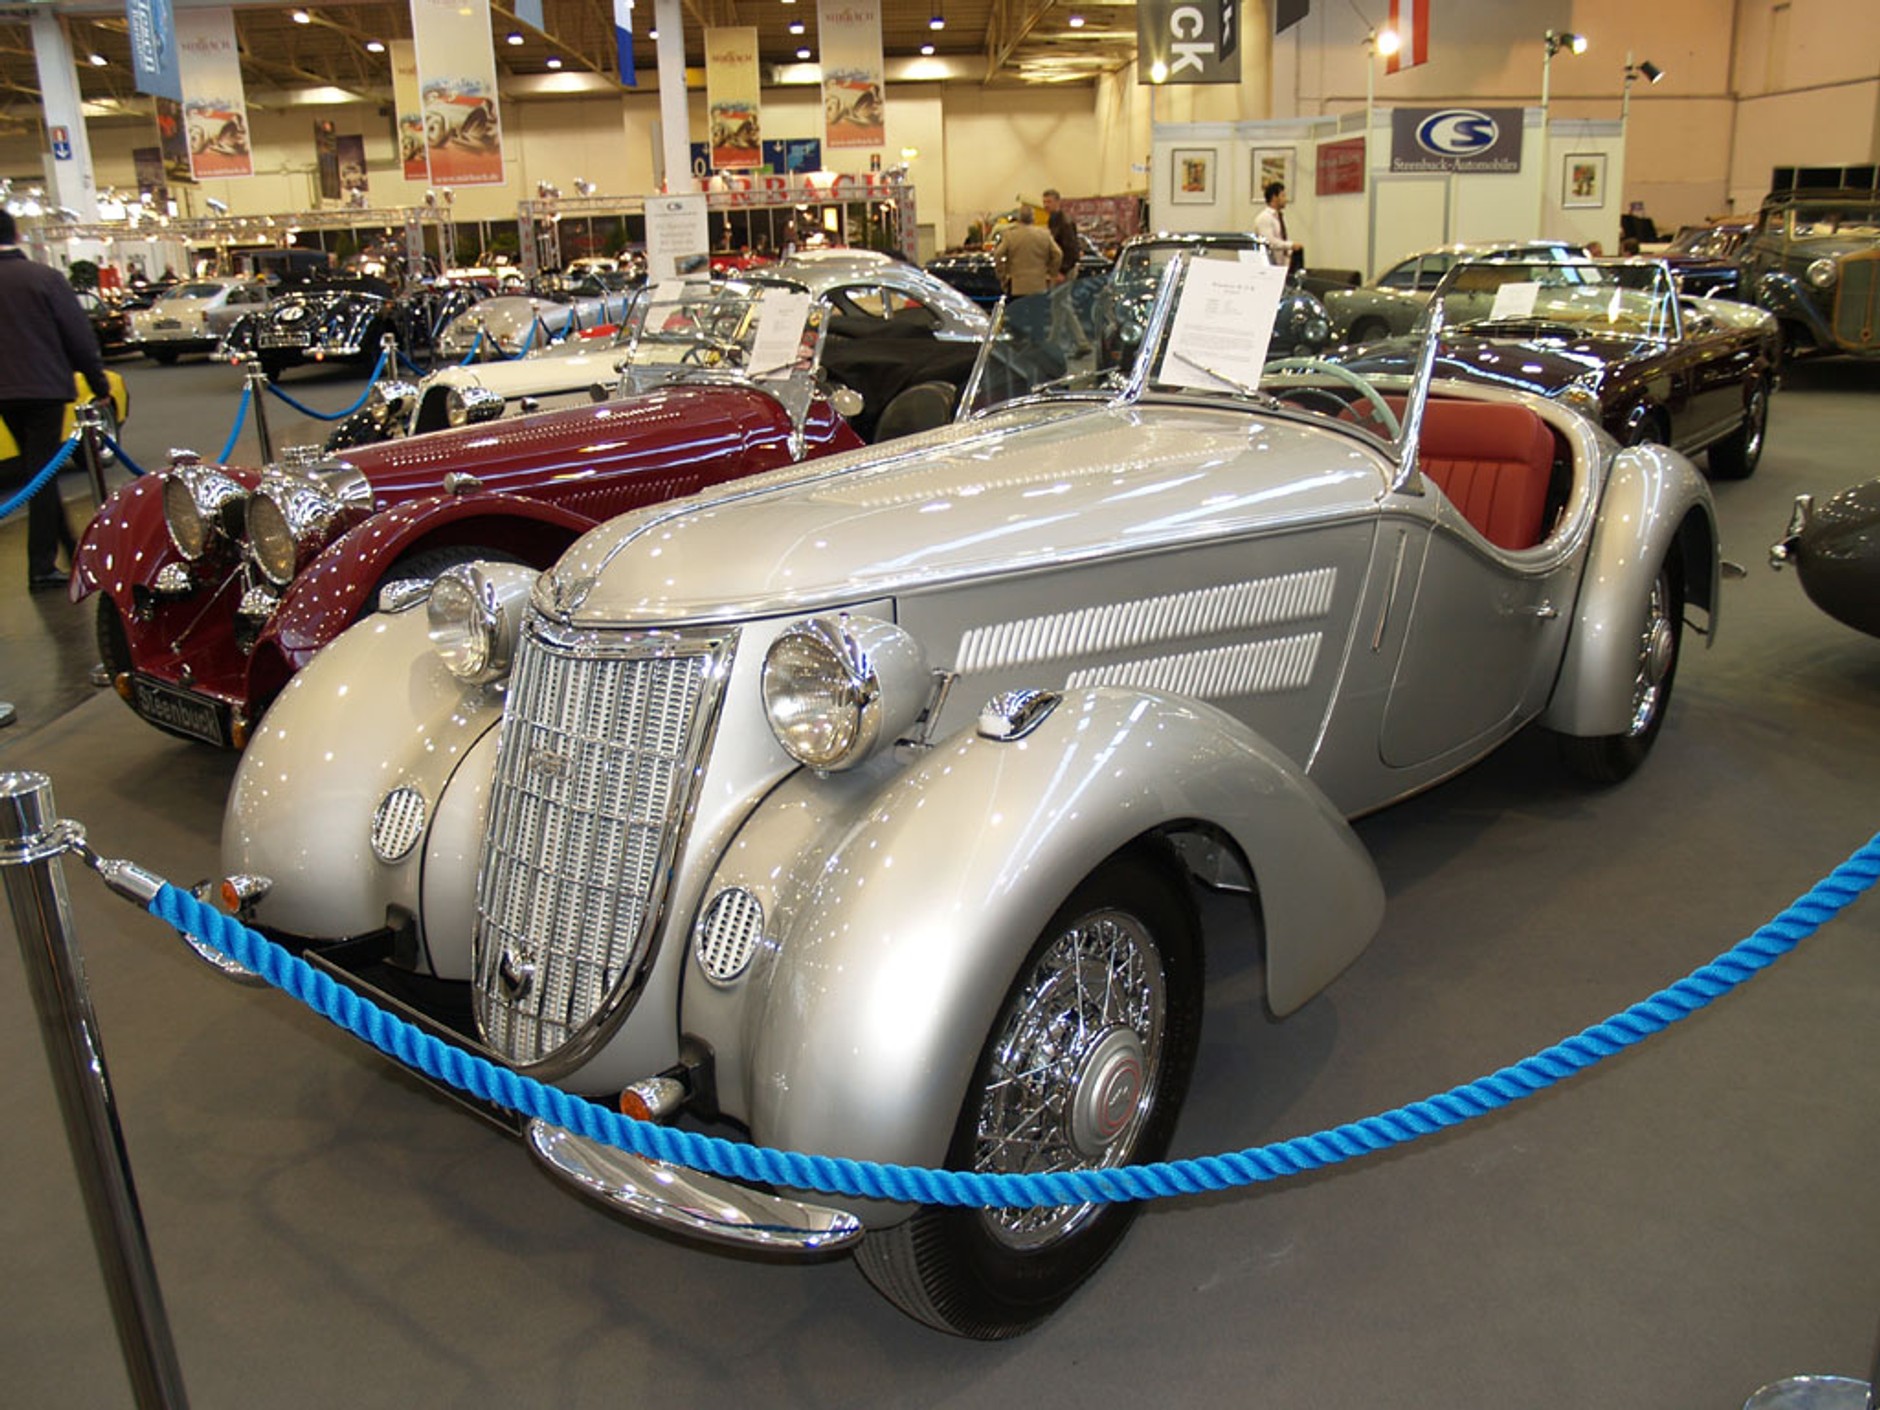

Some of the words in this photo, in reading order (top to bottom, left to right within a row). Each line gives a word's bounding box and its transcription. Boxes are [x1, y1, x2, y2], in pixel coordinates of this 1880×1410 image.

[1170, 5, 1214, 75] ck
[701, 172, 890, 206] IRBACH
[138, 683, 219, 743] Steenbuck
